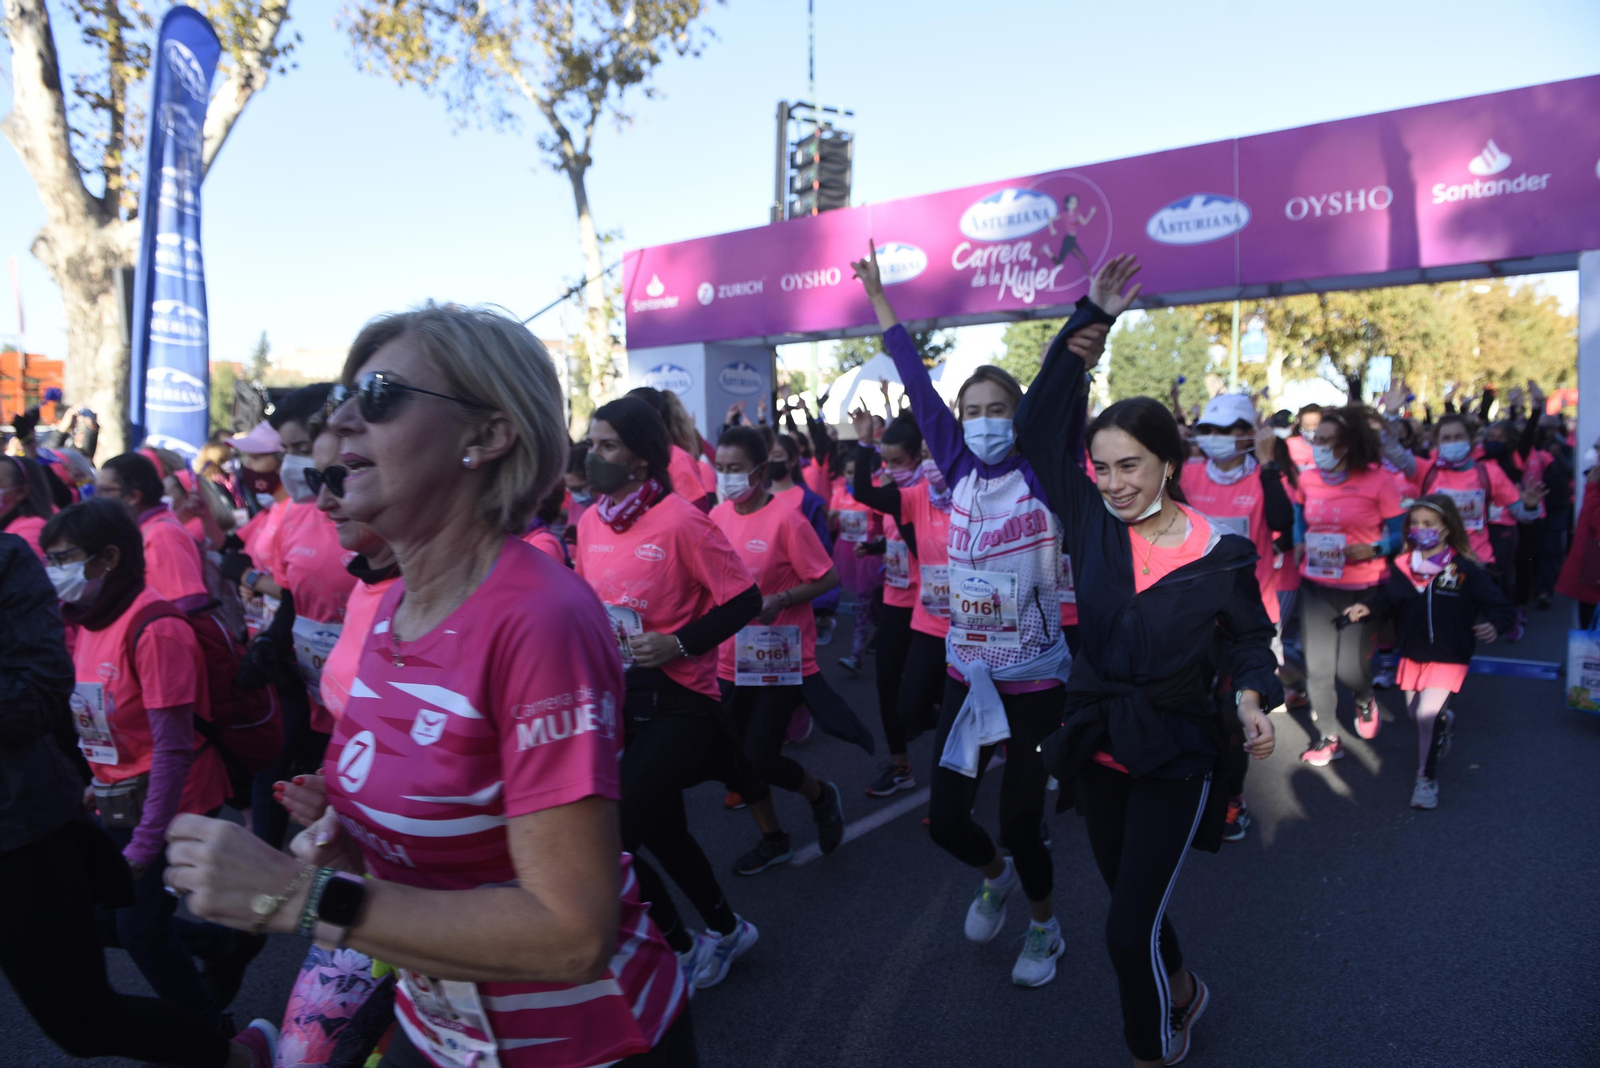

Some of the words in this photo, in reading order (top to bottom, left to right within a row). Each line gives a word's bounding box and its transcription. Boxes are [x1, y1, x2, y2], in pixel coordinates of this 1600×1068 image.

[1432, 172, 1552, 204] Santander
[1285, 185, 1394, 221] OYSHO
[970, 205, 1050, 232] ASTURIANA
[1155, 212, 1242, 238] ASTURIANA
[951, 240, 1033, 270] Carrera
[717, 279, 764, 300] ZURICH
[780, 267, 841, 292] OYSHO
[971, 269, 987, 288] de
[988, 269, 1001, 286] la
[997, 259, 1064, 304] Mujer
[632, 295, 679, 313] Santander
[620, 595, 649, 609] POR
[961, 599, 993, 616] 016
[756, 649, 783, 661] 016
[510, 692, 575, 720] Carrera
